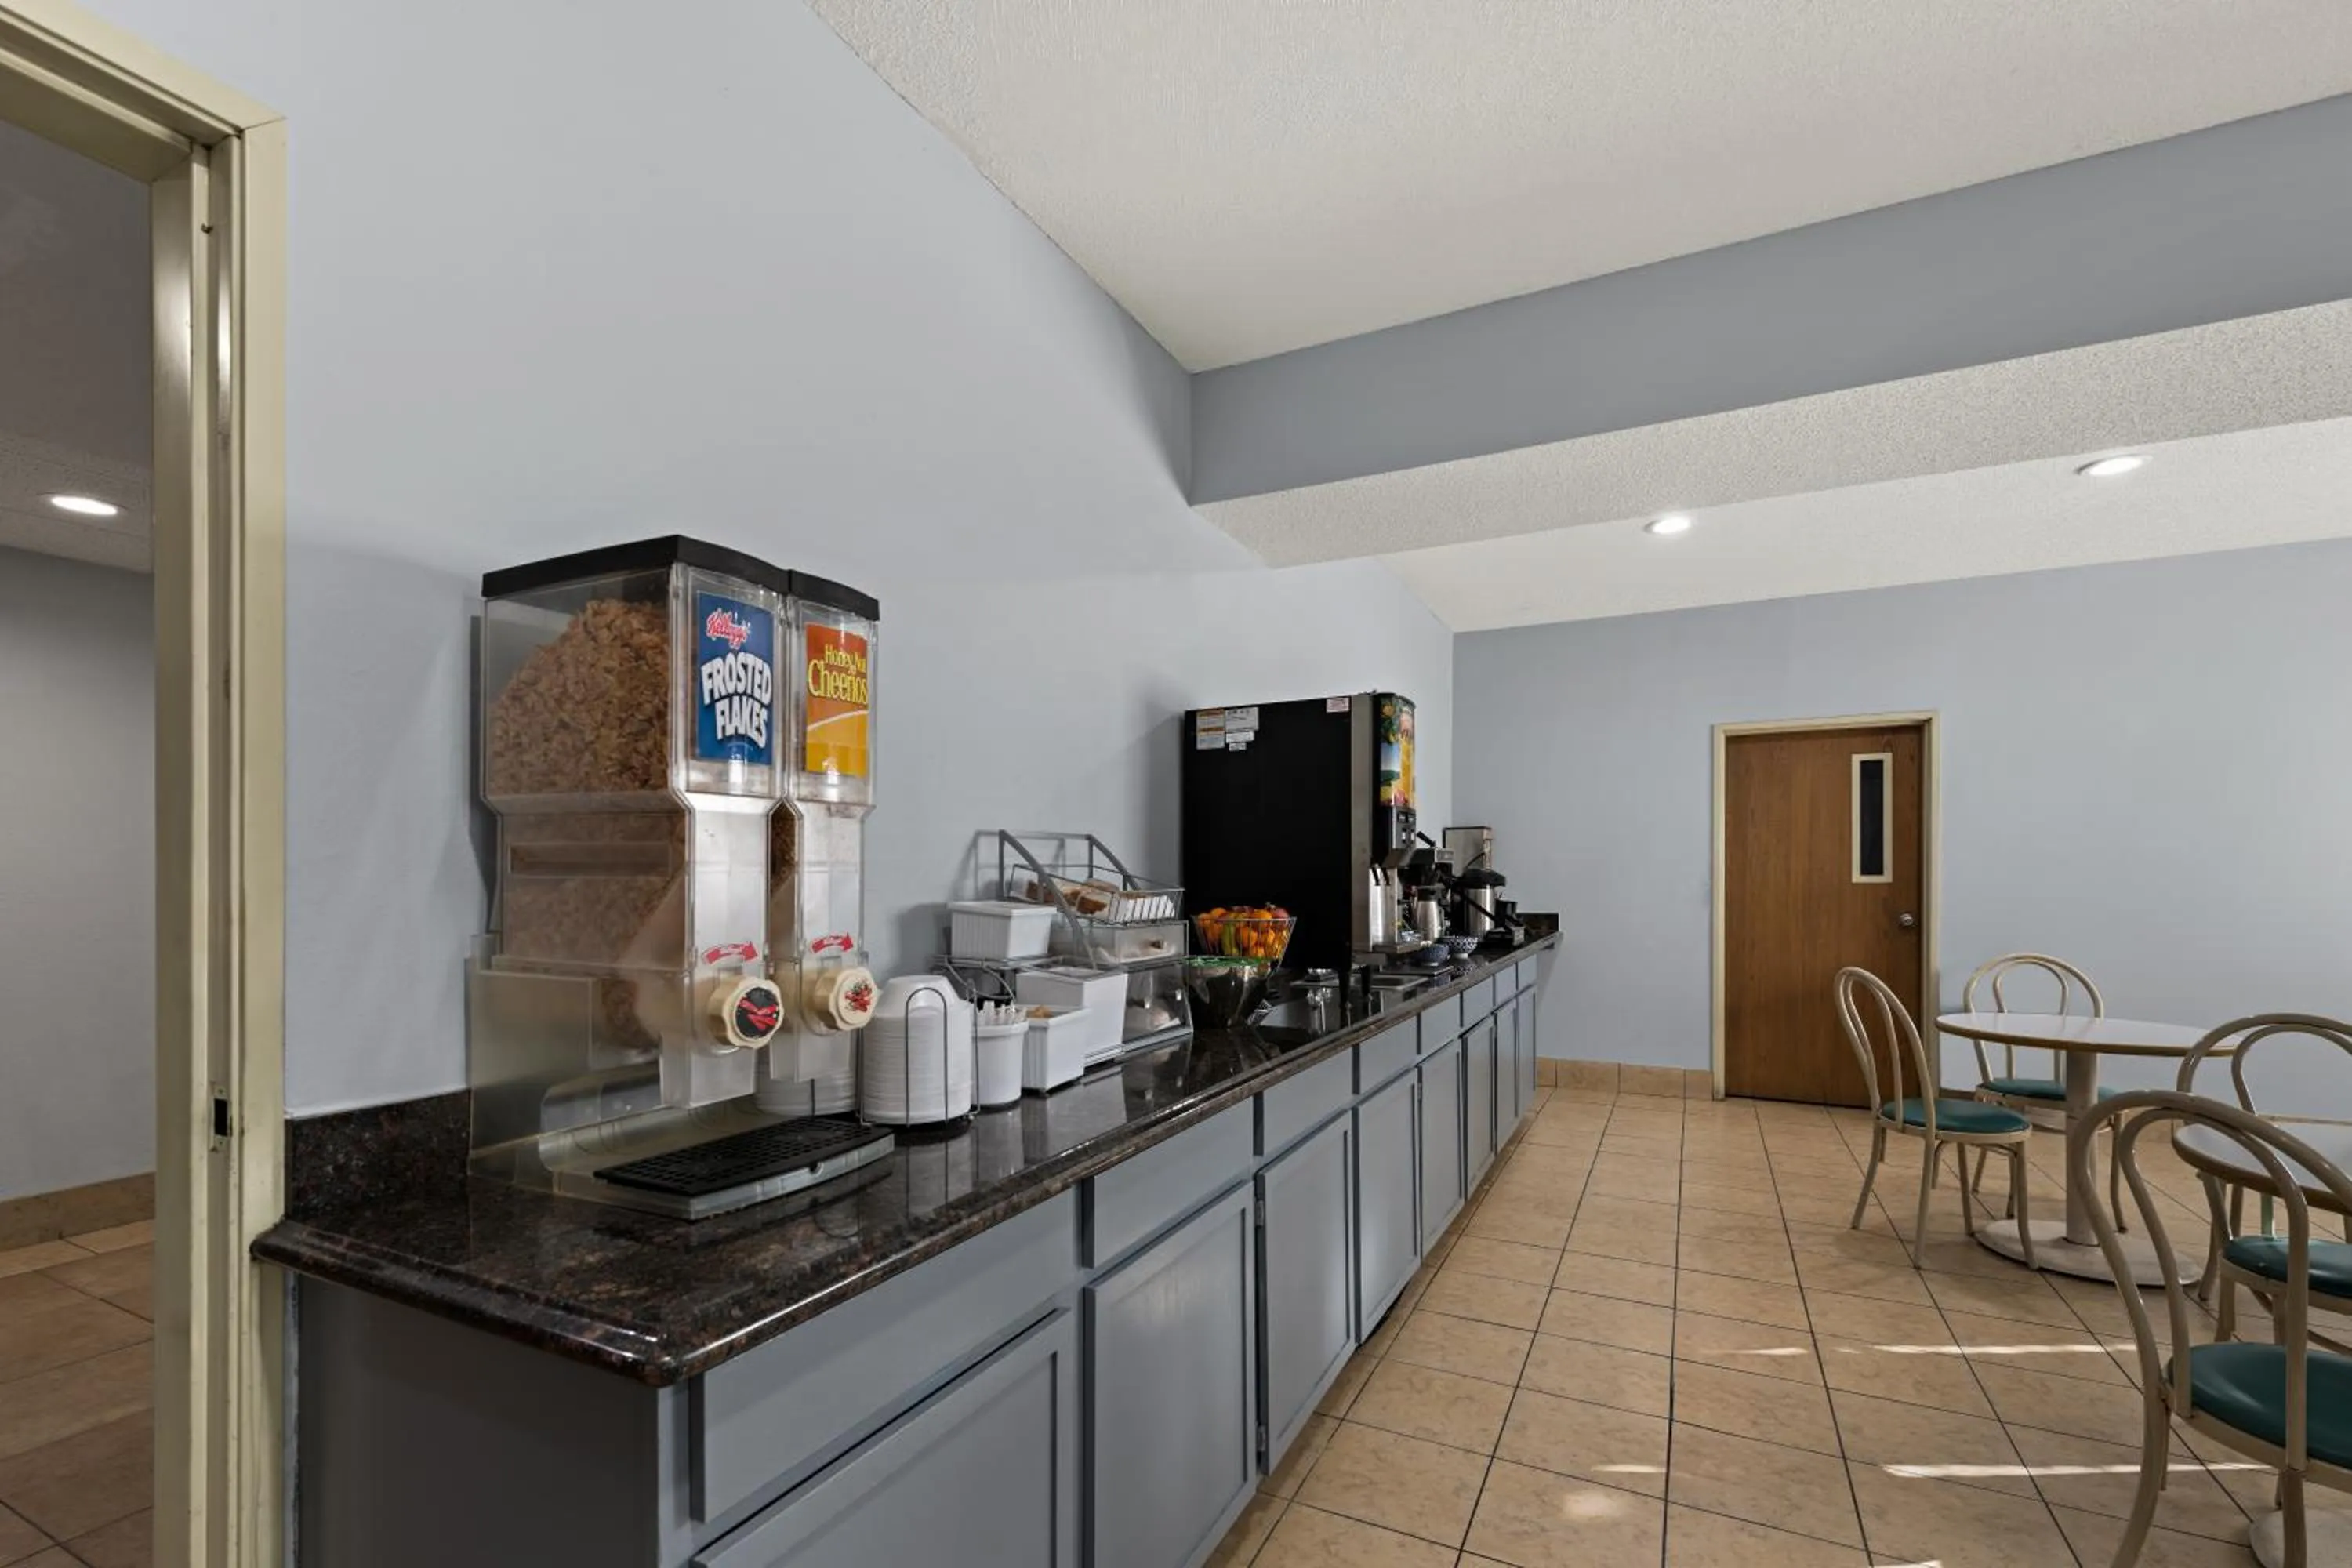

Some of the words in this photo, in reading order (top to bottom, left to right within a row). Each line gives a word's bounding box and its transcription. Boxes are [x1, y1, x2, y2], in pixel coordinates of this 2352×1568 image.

[701, 652, 772, 705] FROSTED
[808, 659, 867, 705] Cheerios
[715, 695, 768, 748] FLAKES
